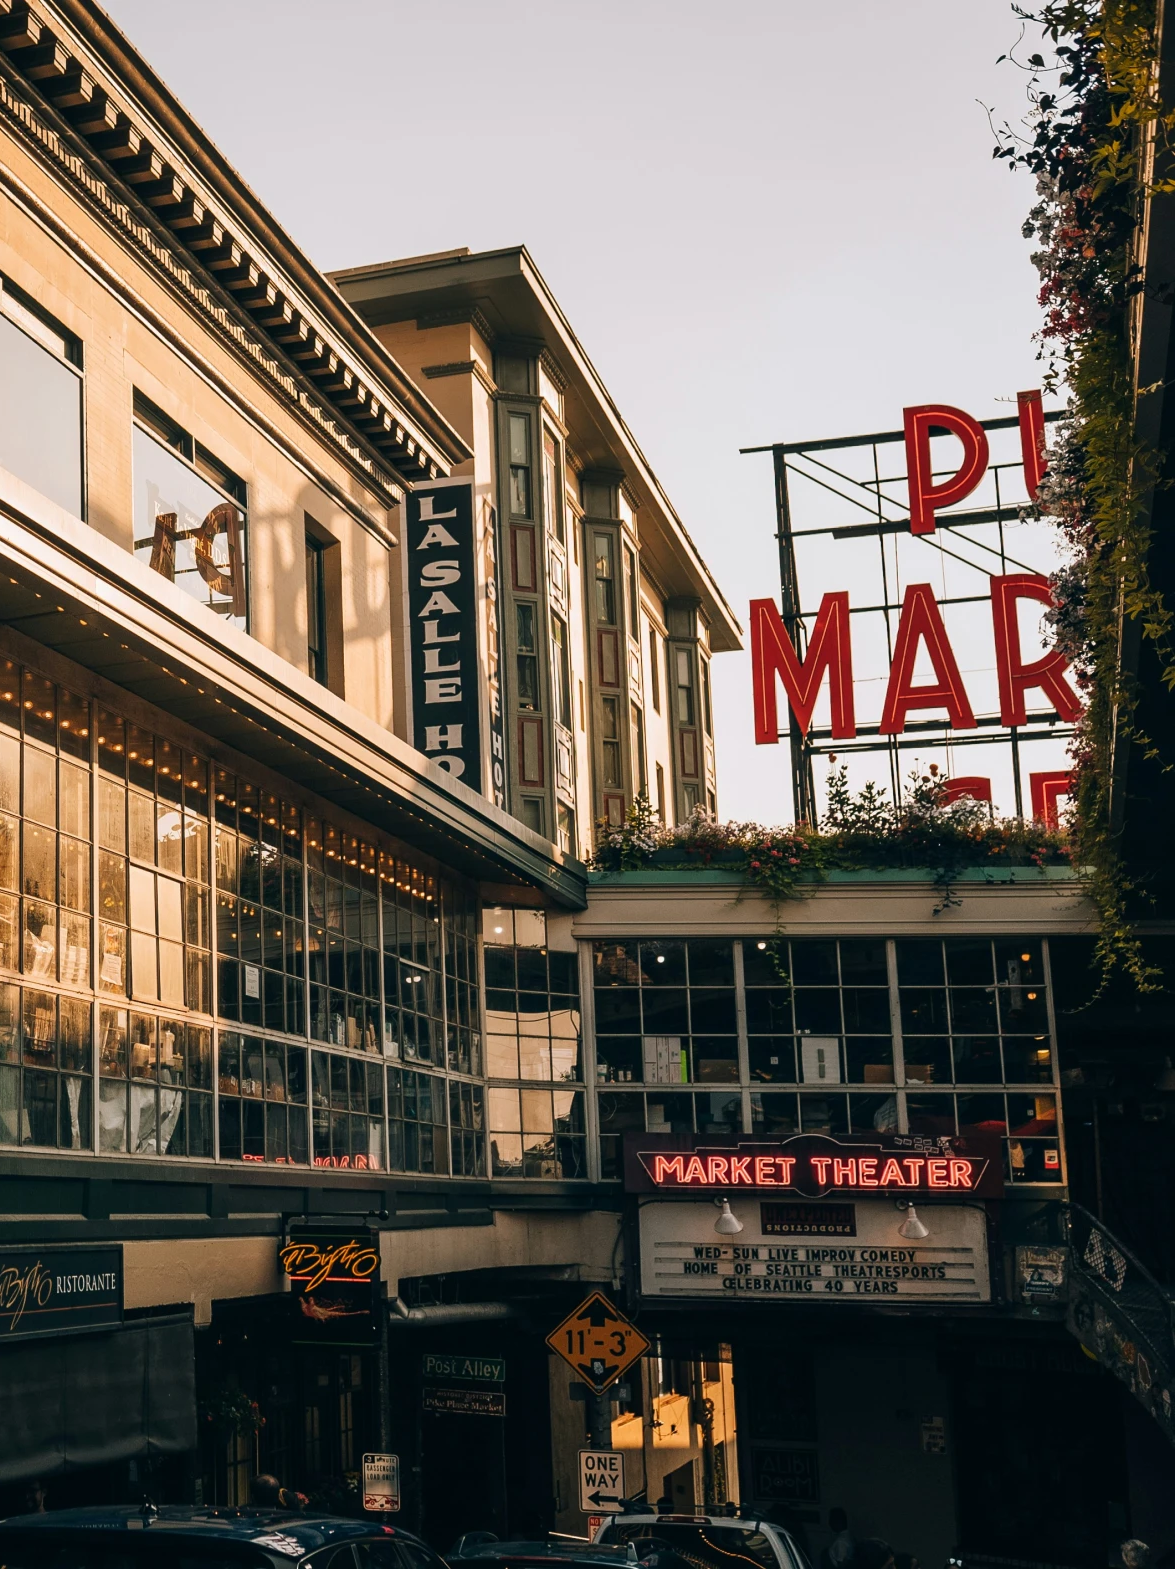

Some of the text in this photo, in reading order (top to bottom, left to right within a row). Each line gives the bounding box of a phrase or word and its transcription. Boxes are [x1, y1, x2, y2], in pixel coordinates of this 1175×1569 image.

[416, 496, 460, 550] LA
[417, 560, 463, 704] SALLE
[654, 1155, 974, 1188] MARKET THEATER
[766, 1224, 851, 1234] PRODUCTIONS
[733, 1247, 759, 1260] SUN
[769, 1248, 798, 1260] LIVE
[805, 1249, 855, 1262] IMPROV
[860, 1250, 916, 1262] COMEDY
[684, 1262, 946, 1278] HOME OF SEATTLE THEATRESPORTS
[56, 1272, 116, 1294] RISTORANTE
[723, 1278, 898, 1293] CELEBRATING 40 YEARS
[426, 1356, 501, 1380] Post Alley
[425, 1398, 503, 1412] Pike Place Market
[585, 1455, 619, 1472] ONE
[584, 1472, 619, 1489] WAY
[590, 1517, 599, 1525] NO
